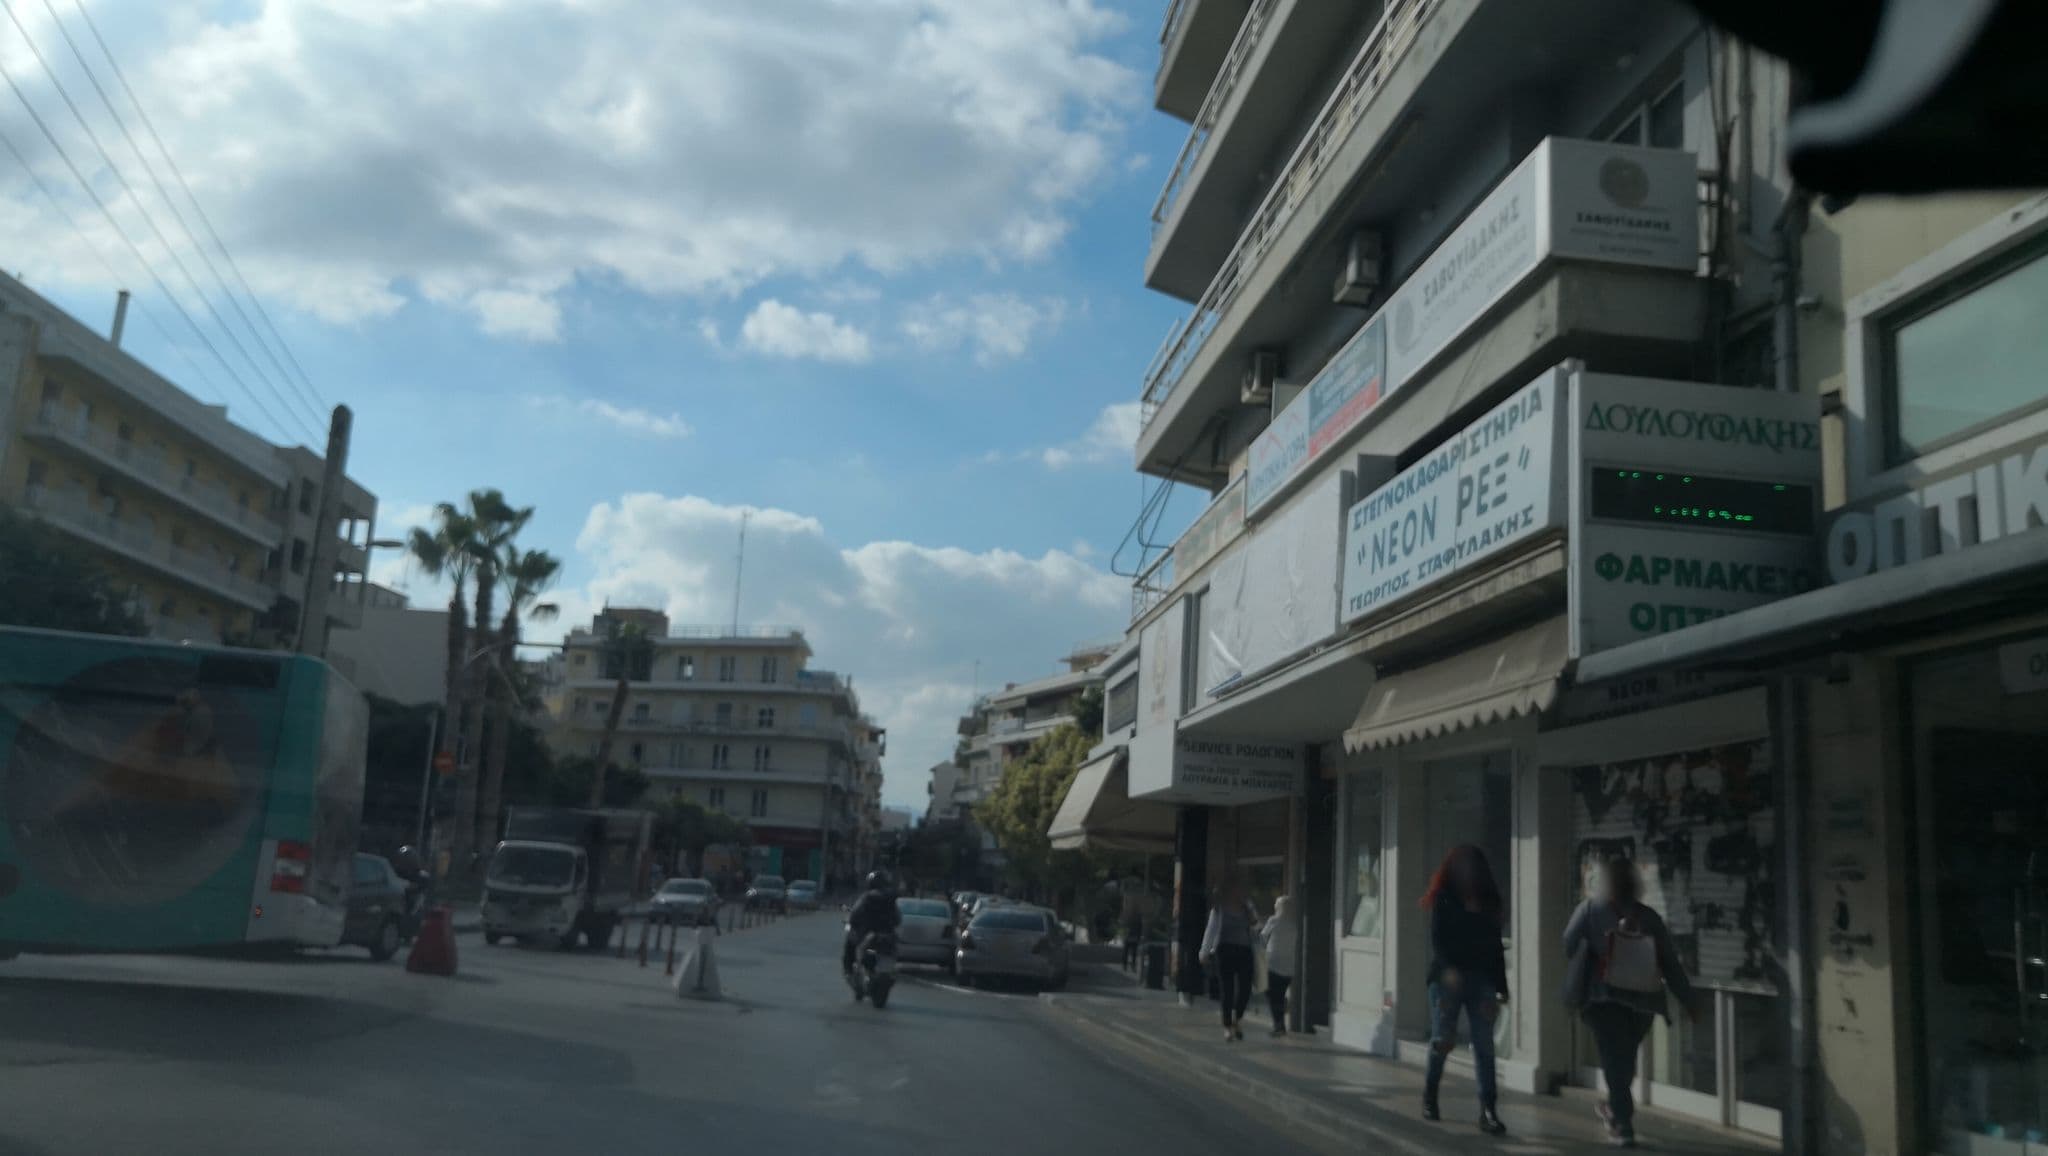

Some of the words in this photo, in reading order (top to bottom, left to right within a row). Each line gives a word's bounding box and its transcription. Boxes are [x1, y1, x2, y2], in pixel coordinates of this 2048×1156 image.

[1353, 387, 1542, 531] ΣΤΕΓΝΟΚΑΘΑΡΙΣΤΗΡΙΑ
[1585, 402, 1819, 453] ΔΟΥΛΟΥΦΑΚΗΣ
[1350, 569, 1409, 612] ΓΕΩΡΓΙΟΣ
[1417, 504, 1534, 581] ΣΤΑΦΥΛΑΚΗΣ
[1183, 742, 1232, 755] SERVICE
